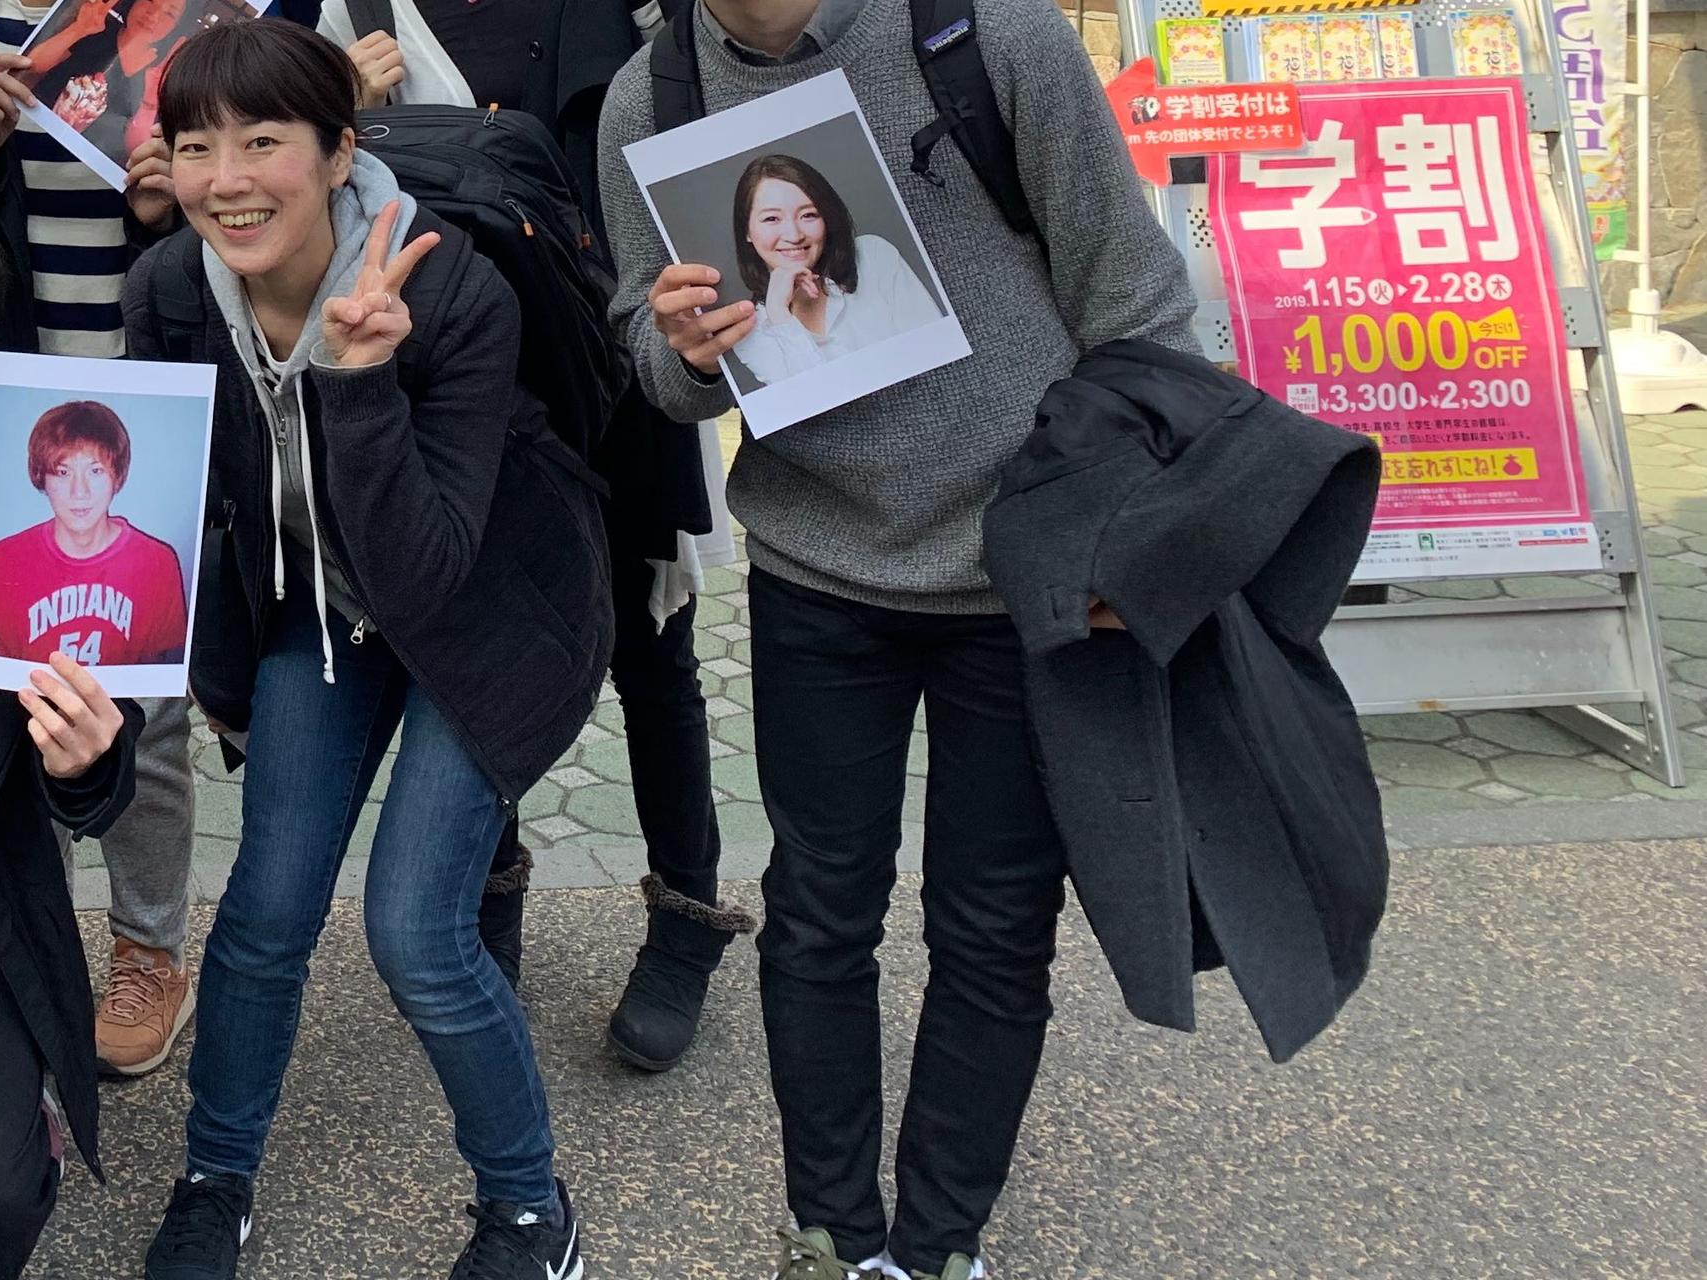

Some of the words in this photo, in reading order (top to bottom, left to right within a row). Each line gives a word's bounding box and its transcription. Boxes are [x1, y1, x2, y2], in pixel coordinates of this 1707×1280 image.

[1165, 91, 1291, 121] 学割受付は
[1237, 113, 1520, 269] 学割
[1409, 272, 1486, 304] 2.28
[1282, 310, 1469, 377] ¥1,000
[1474, 345, 1528, 370] OFF
[1320, 382, 1418, 413] ¥3,300
[1430, 379, 1531, 410] ¥2,300
[28, 583, 133, 645] INDIANA
[59, 630, 103, 666] 54
